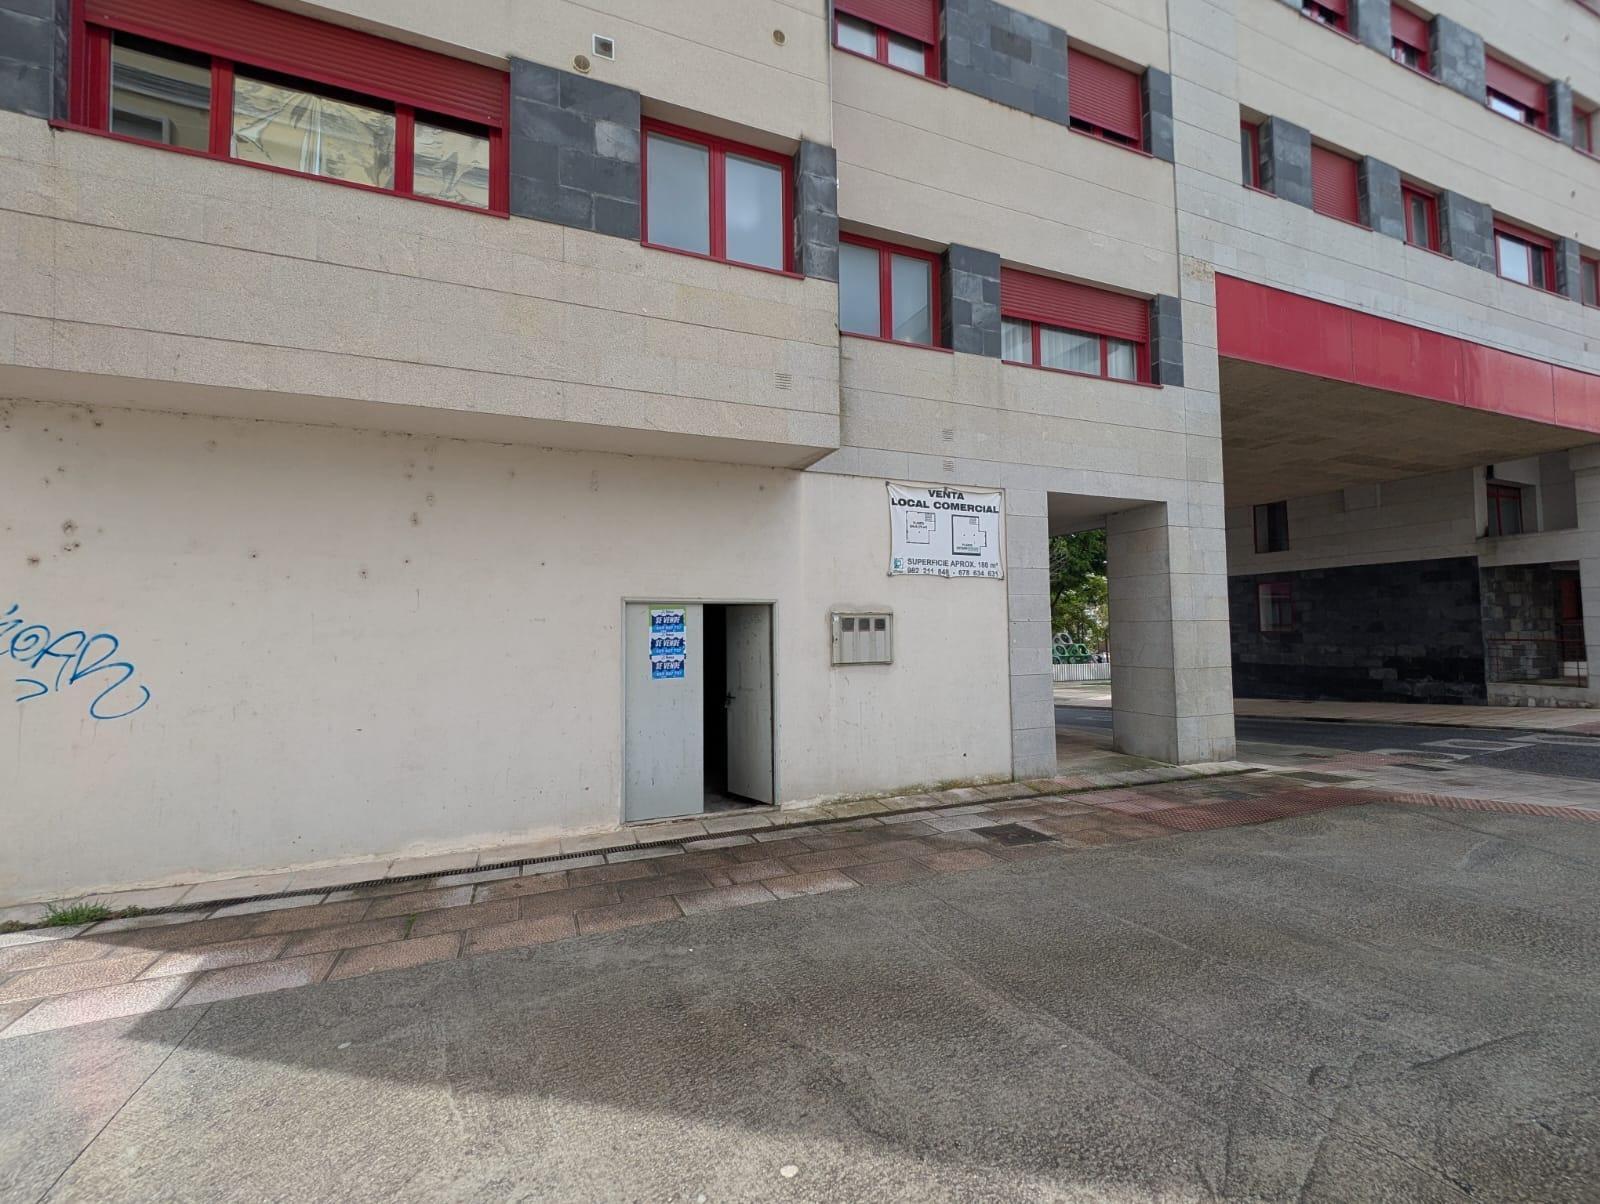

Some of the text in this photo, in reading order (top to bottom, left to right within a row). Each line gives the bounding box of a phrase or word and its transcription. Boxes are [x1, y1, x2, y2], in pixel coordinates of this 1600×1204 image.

[928, 490, 964, 500] VENTA
[891, 498, 999, 513] LOCAL COMERCIAL
[907, 558, 949, 566] SUPERFICIE
[950, 560, 976, 568] APROX.
[663, 616, 680, 624] VENDE
[663, 639, 680, 647] VENDE
[663, 662, 680, 670] VENDE
